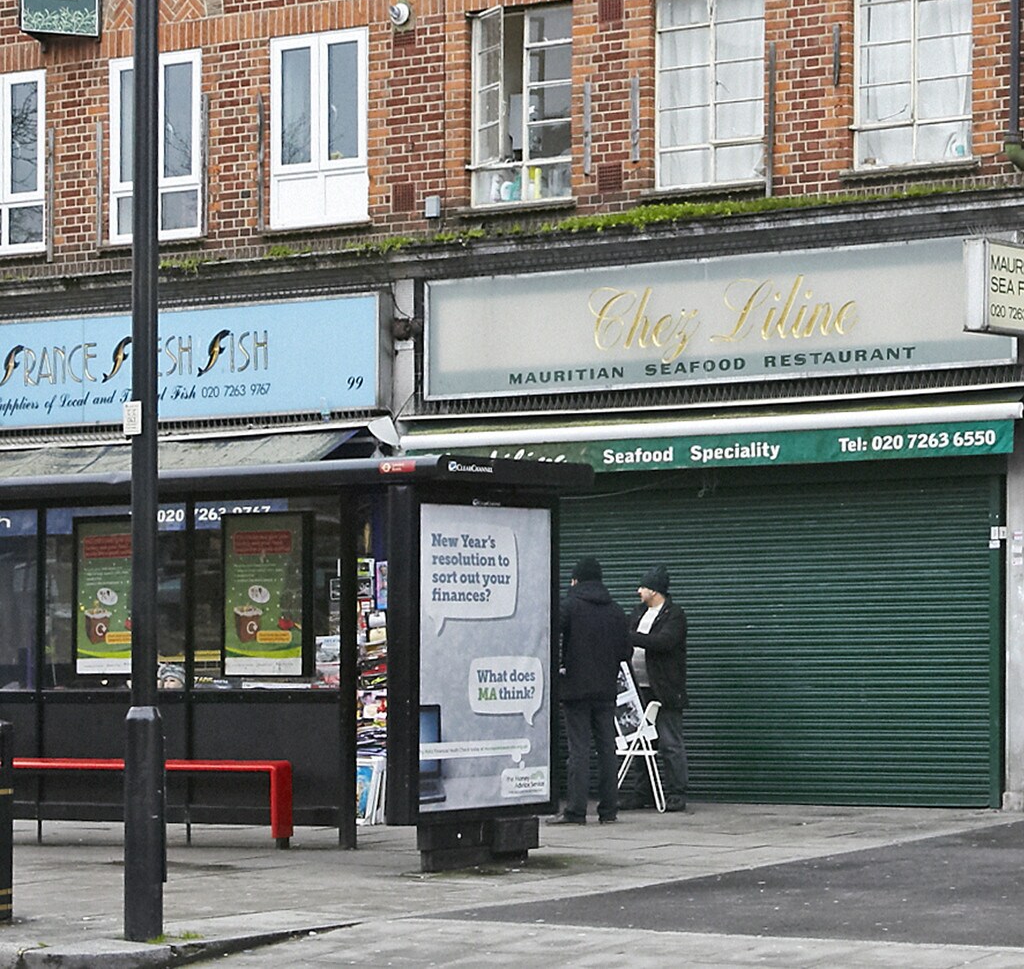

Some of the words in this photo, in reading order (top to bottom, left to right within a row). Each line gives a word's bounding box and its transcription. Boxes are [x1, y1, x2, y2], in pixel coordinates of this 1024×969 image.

[990, 276, 1015, 295] SEA
[589, 286, 701, 364] Chez
[710, 274, 861, 343] Liline
[990, 304, 1006, 318] 020
[102, 335, 193, 383] FSH
[197, 329, 269, 377] FISH
[509, 366, 625, 385] MAURITIAN
[645, 357, 746, 376] SEAFOOD
[764, 346, 916, 368] RESTAURANT
[171, 385, 196, 400] Fish
[201, 386, 220, 398] 020
[224, 385, 246, 397] 7263
[250, 383, 271, 395] 9767
[347, 376, 365, 391] 99
[0, 395, 39, 416] uppliers
[44, 394, 57, 414] of
[59, 390, 90, 409] Local
[92, 390, 116, 405] and
[603, 446, 673, 465] Seafood
[690, 441, 780, 464] Speciality
[839, 436, 867, 453] Tel:
[872, 434, 903, 451] 020
[907, 432, 949, 449] 7263
[953, 430, 996, 447] 6550
[157, 509, 185, 523] 020
[431, 533, 458, 547] New
[461, 533, 496, 549] Year's
[432, 552, 496, 567] resolution
[498, 554, 510, 567] to
[432, 571, 456, 584] sort
[460, 571, 480, 584] out
[482, 574, 511, 588] your
[431, 588, 491, 602] finances?
[477, 669, 508, 683] What
[510, 669, 536, 682] does
[478, 687, 497, 701] MA
[499, 686, 535, 701] think?
